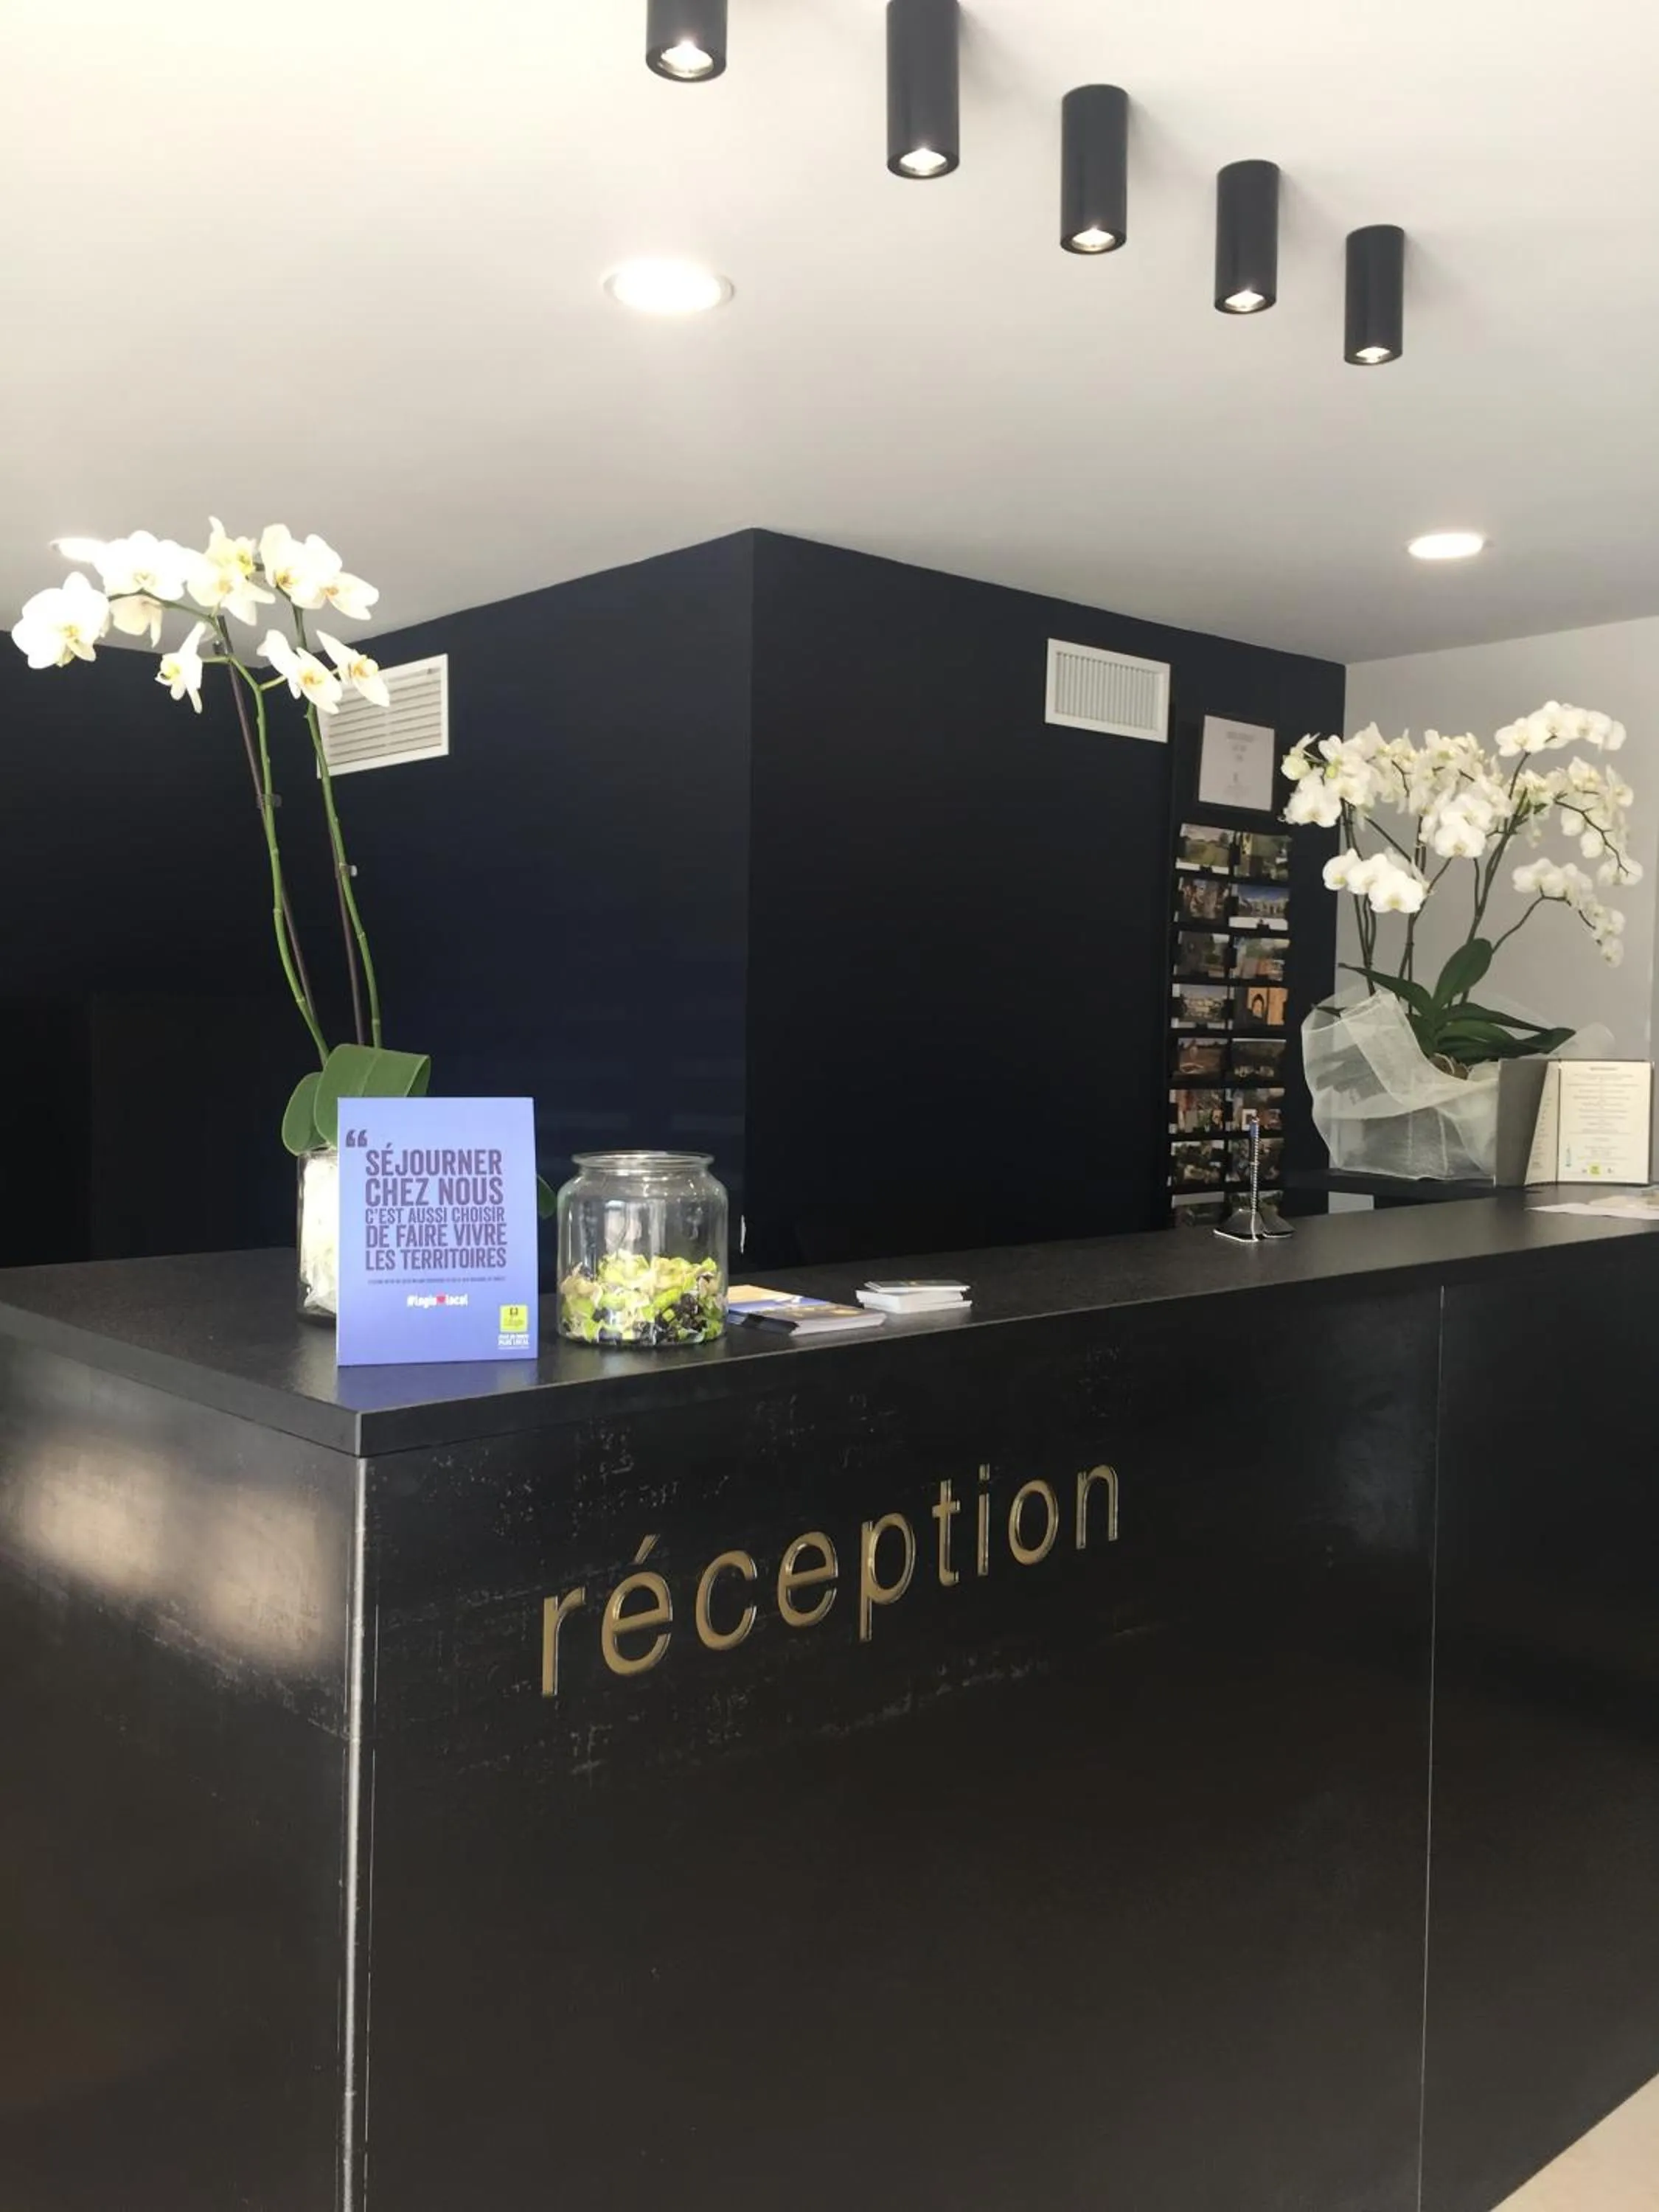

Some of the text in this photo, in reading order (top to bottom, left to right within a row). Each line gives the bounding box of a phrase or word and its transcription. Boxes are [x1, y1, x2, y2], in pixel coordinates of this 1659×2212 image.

[366, 1143, 503, 1176] SÉJOURNER
[365, 1177, 504, 1207] CHEZ NOUS
[365, 1206, 505, 1225] C'EST AUSSI CHOISIR
[365, 1223, 507, 1248] DE FAIRE VIVRE
[365, 1248, 507, 1271] LES TERRITOIRES
[542, 1462, 1120, 1697] réception
